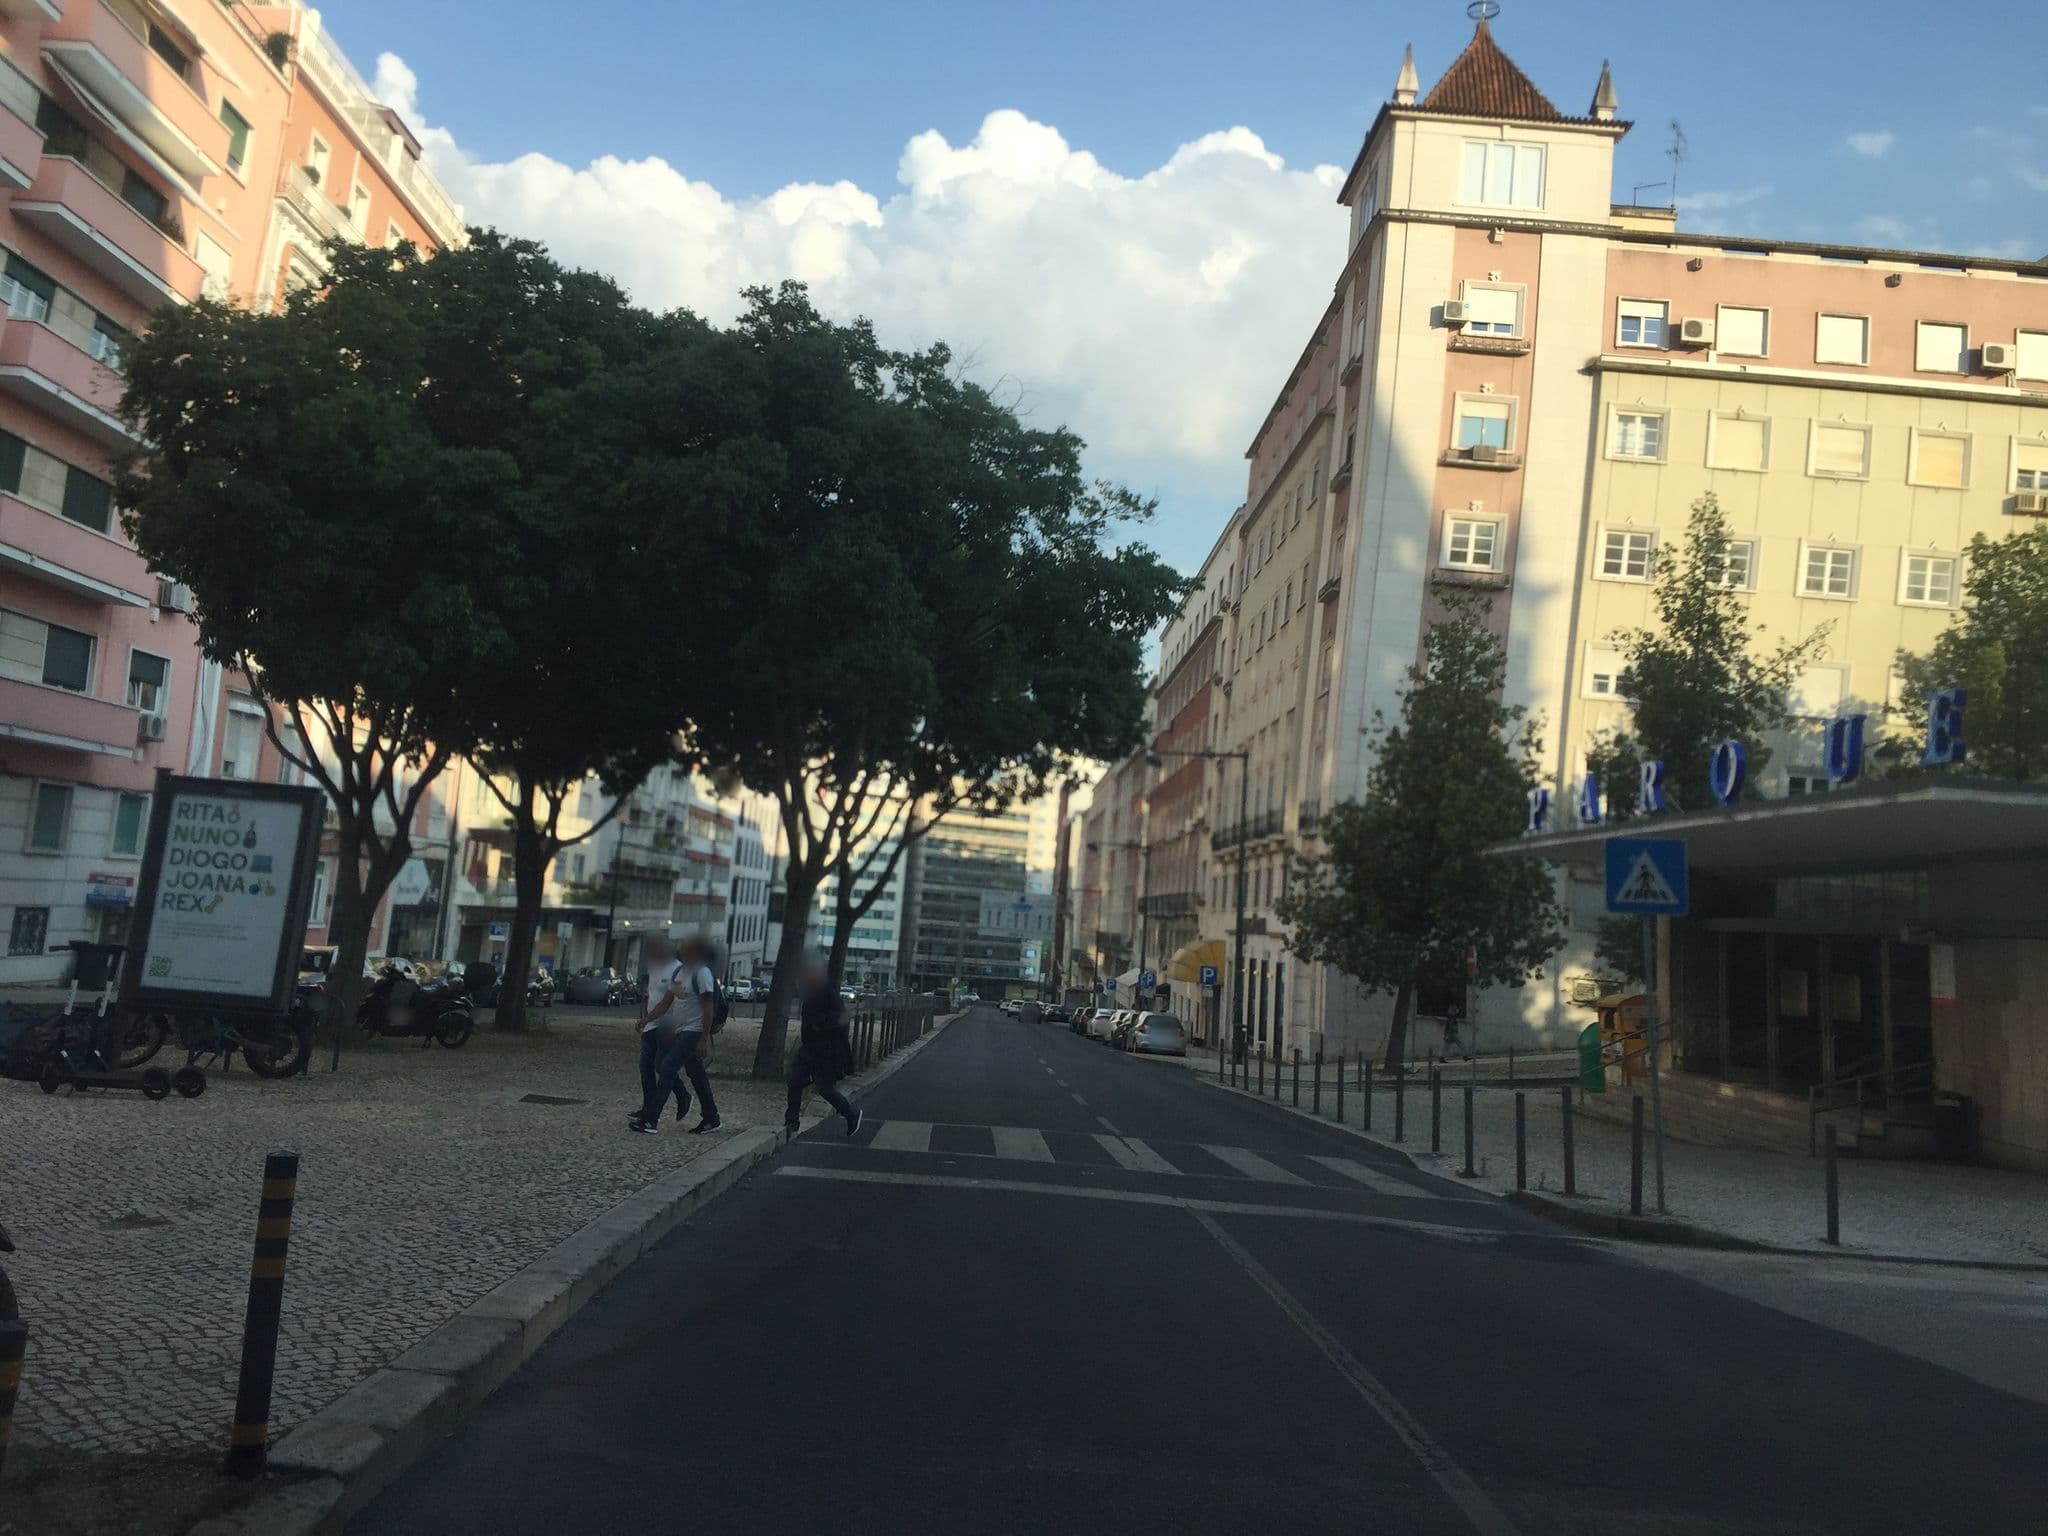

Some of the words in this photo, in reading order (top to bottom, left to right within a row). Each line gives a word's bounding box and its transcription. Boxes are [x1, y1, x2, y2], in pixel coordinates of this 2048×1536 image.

[1528, 687, 1969, 831] PARQUE
[177, 802, 225, 822] RITA
[174, 825, 240, 847] NUNO
[169, 848, 247, 870] DIOGO
[166, 872, 245, 894] JOANA
[161, 893, 206, 912] REX
[1203, 968, 1214, 983] P
